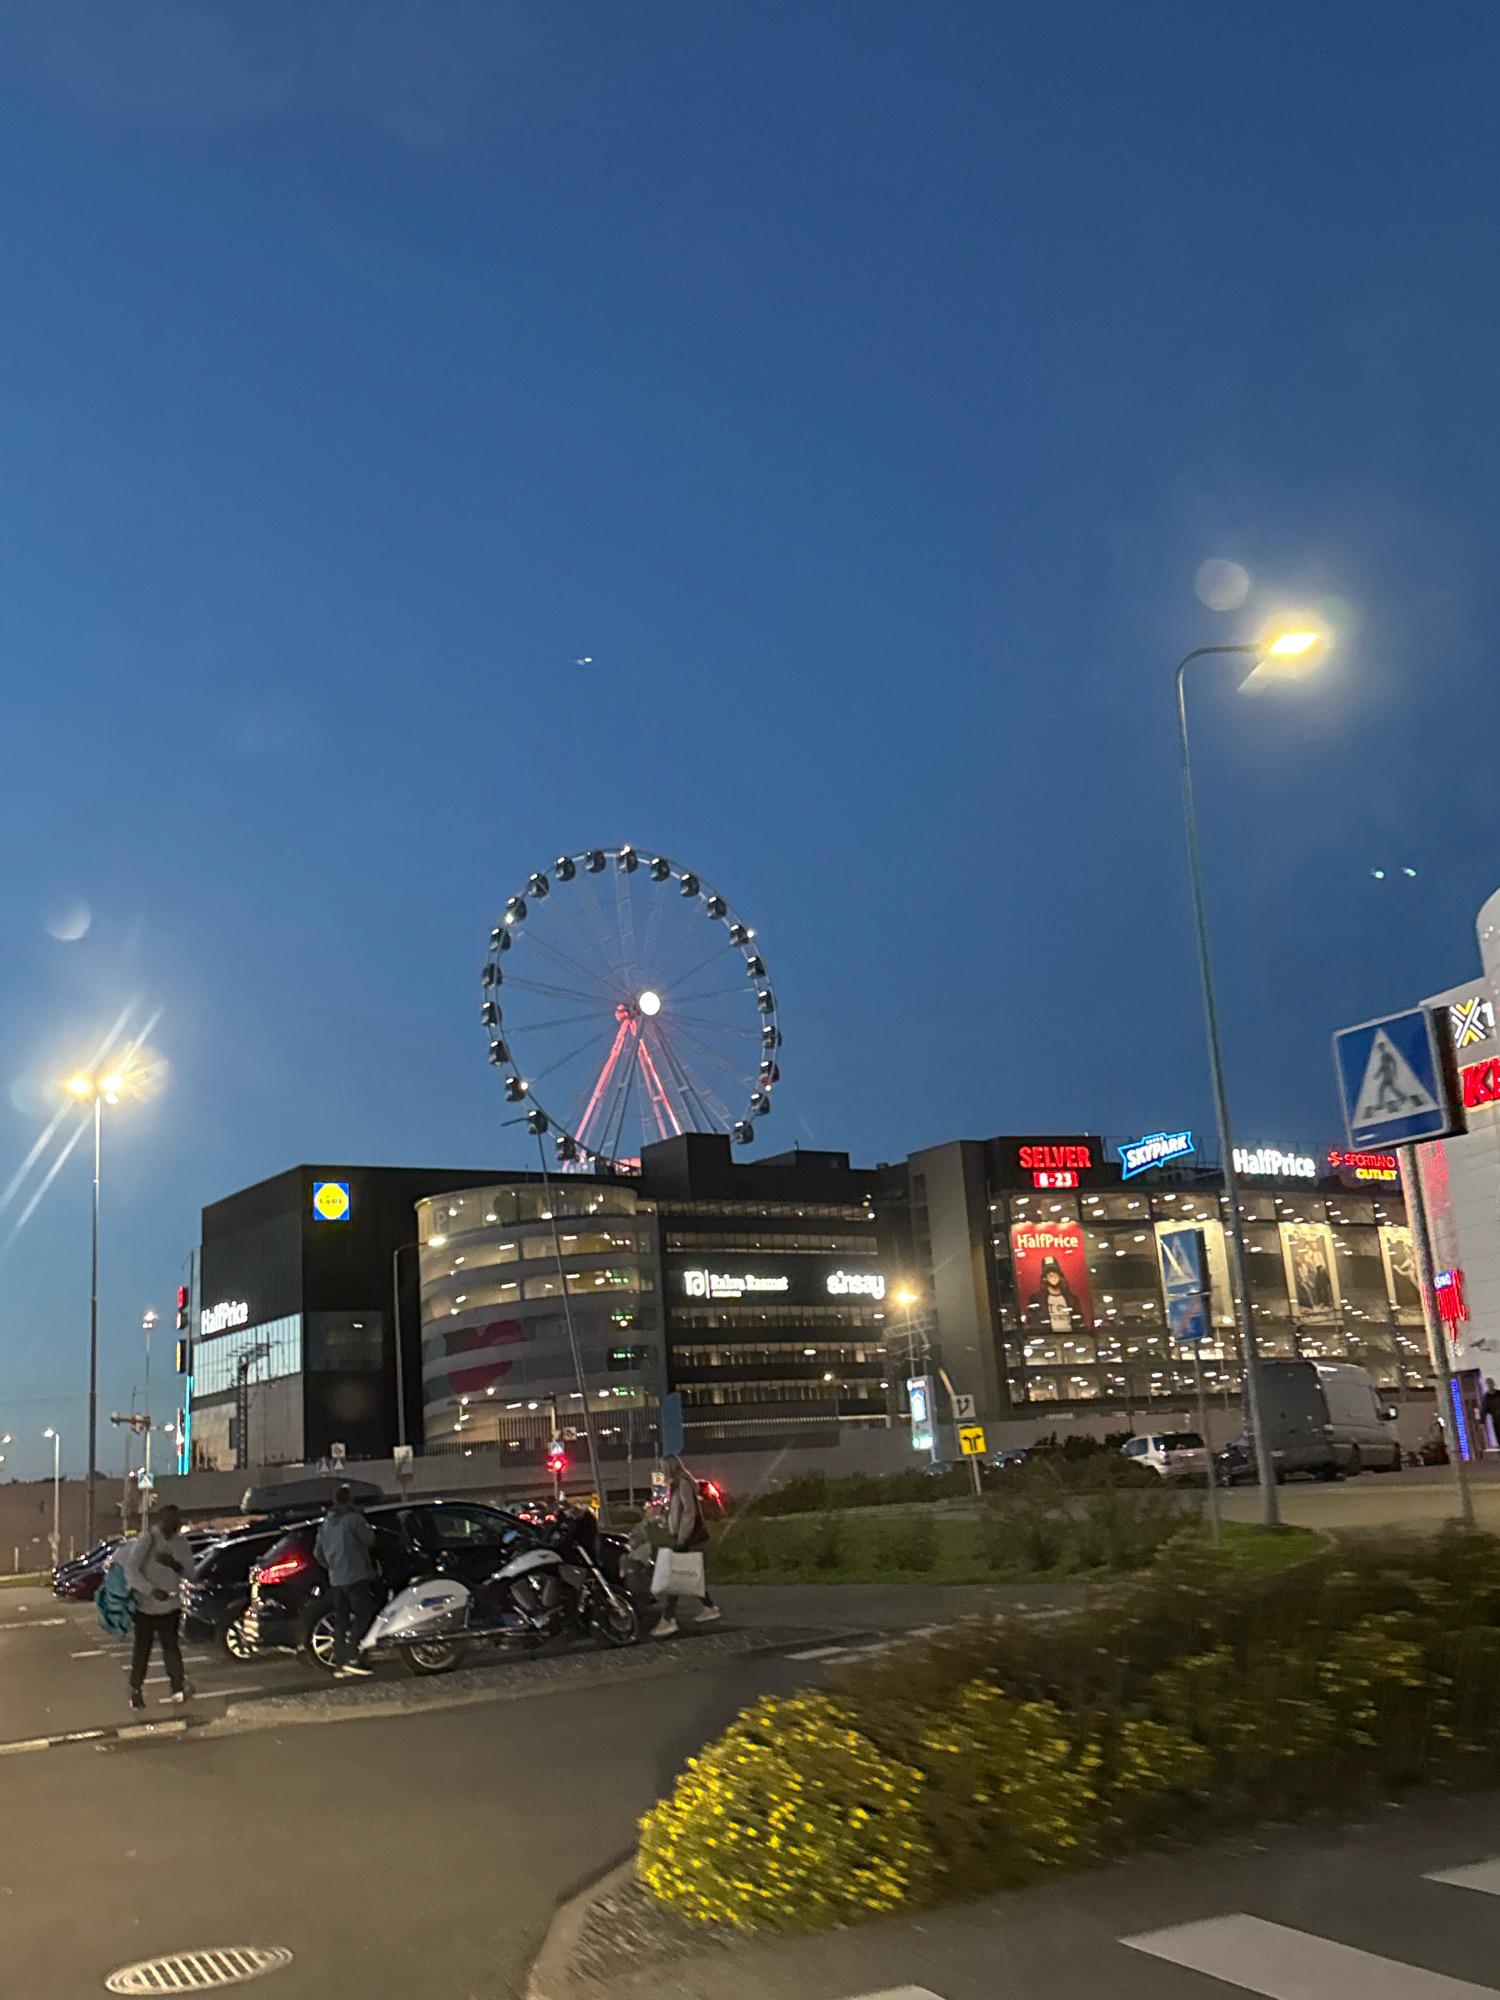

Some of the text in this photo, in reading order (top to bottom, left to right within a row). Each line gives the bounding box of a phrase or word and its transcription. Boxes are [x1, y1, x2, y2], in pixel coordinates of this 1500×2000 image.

[1018, 1145, 1092, 1169] SELVER
[1126, 1135, 1188, 1168] SKYPARK
[1232, 1148, 1316, 1178] HalfPrice
[1344, 1153, 1396, 1169] SPORTLAND
[1355, 1168, 1398, 1181] OUTLET
[1016, 1233, 1079, 1249] HalfPrice
[826, 1270, 886, 1300] sinsay
[201, 1300, 249, 1335] HalfPrice
